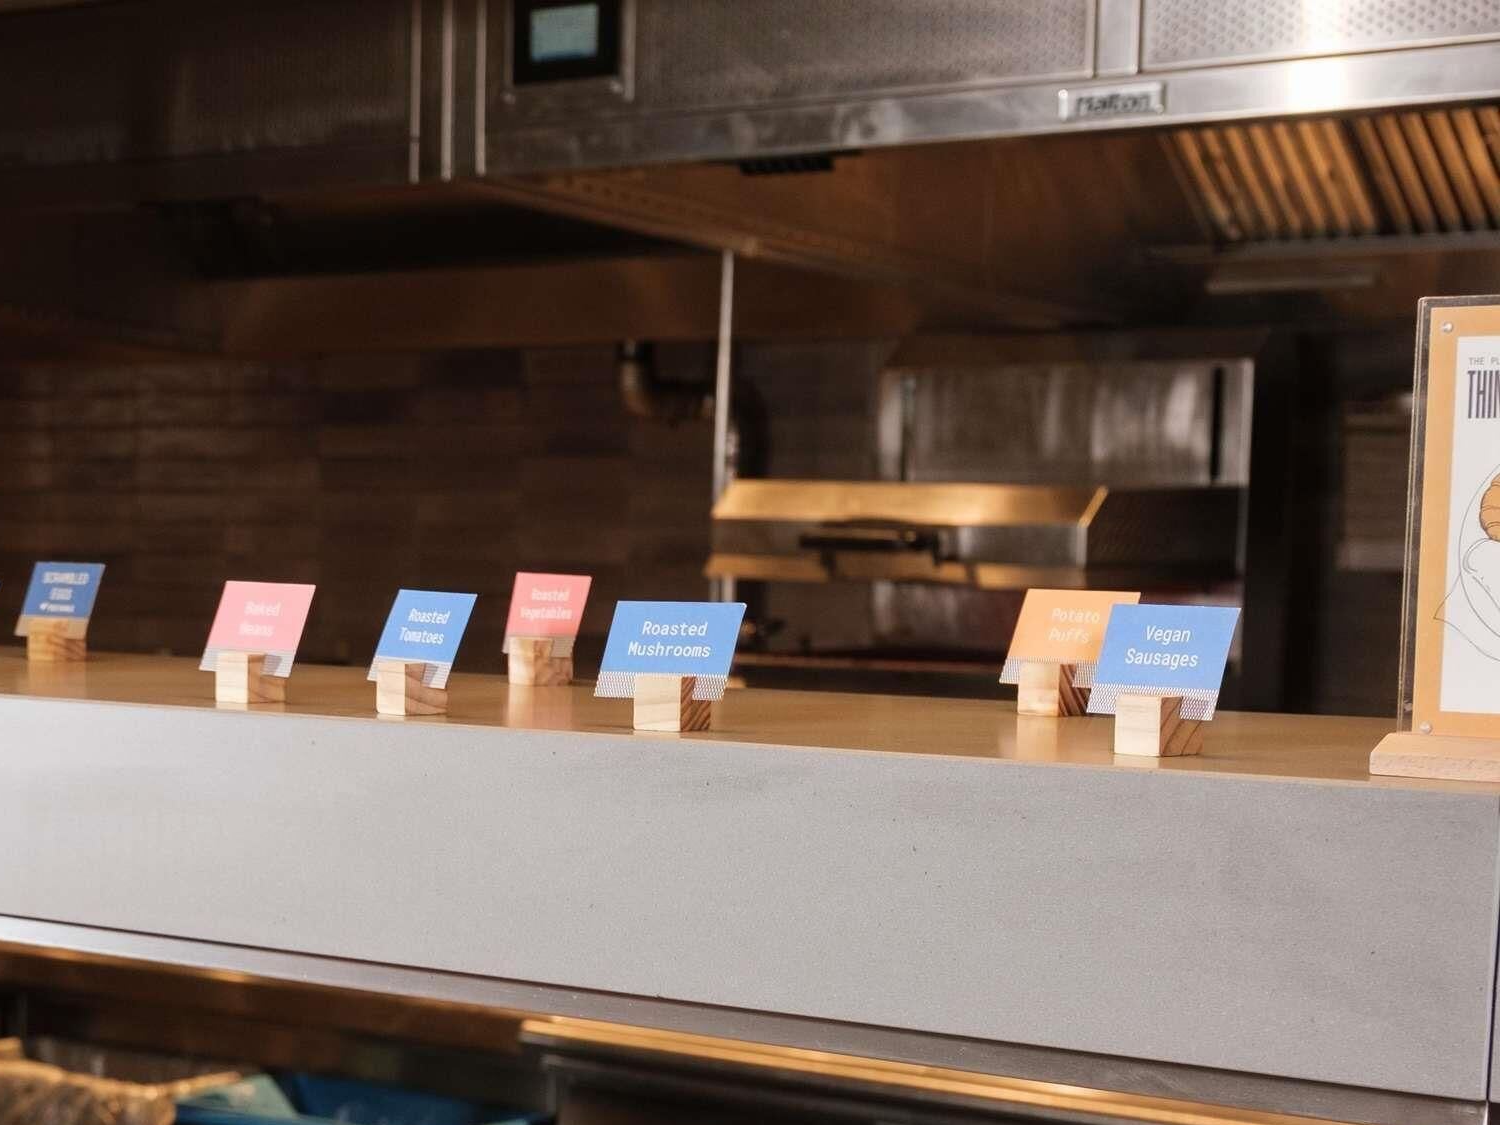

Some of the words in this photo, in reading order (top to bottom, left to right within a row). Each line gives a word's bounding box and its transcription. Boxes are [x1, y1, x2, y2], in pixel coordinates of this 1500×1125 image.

[1468, 356, 1485, 366] THE
[408, 607, 451, 625] Roasted
[1051, 608, 1100, 624] Potato
[399, 626, 445, 645] Tomatoes
[641, 620, 708, 637] Roasted
[1048, 627, 1090, 644] Puffs
[1145, 625, 1191, 645] Vegan
[627, 640, 711, 658] Mushrooms
[1124, 647, 1199, 671] Sausages
